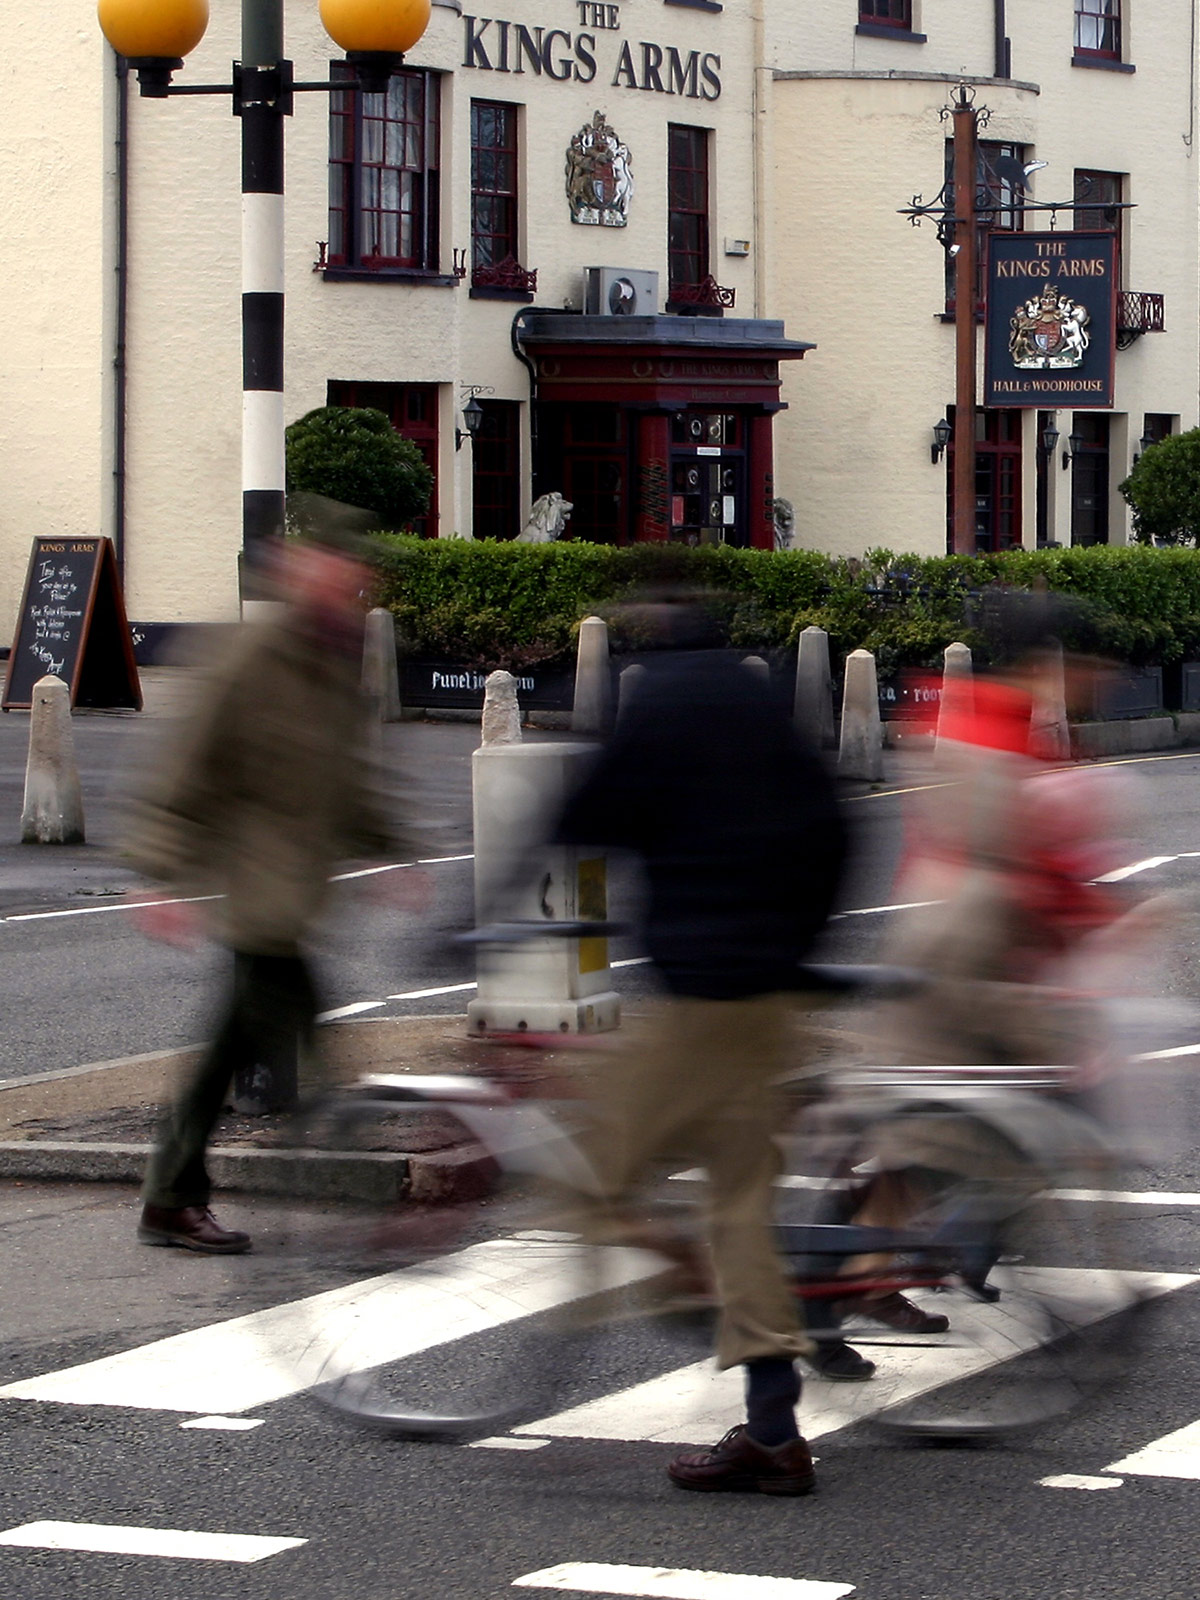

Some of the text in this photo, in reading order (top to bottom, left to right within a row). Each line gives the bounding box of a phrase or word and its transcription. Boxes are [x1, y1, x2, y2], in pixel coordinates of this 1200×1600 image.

[576, 1, 620, 30] THE
[461, 15, 721, 101] KINGS ARMS
[1035, 242, 1067, 257] THE
[996, 259, 1105, 278] KINGS ARMS
[993, 380, 1022, 392] HALL
[1032, 379, 1103, 392] WOODHOUSE
[39, 543, 95, 553] KINGS ARMS
[432, 670, 486, 690] Functio
